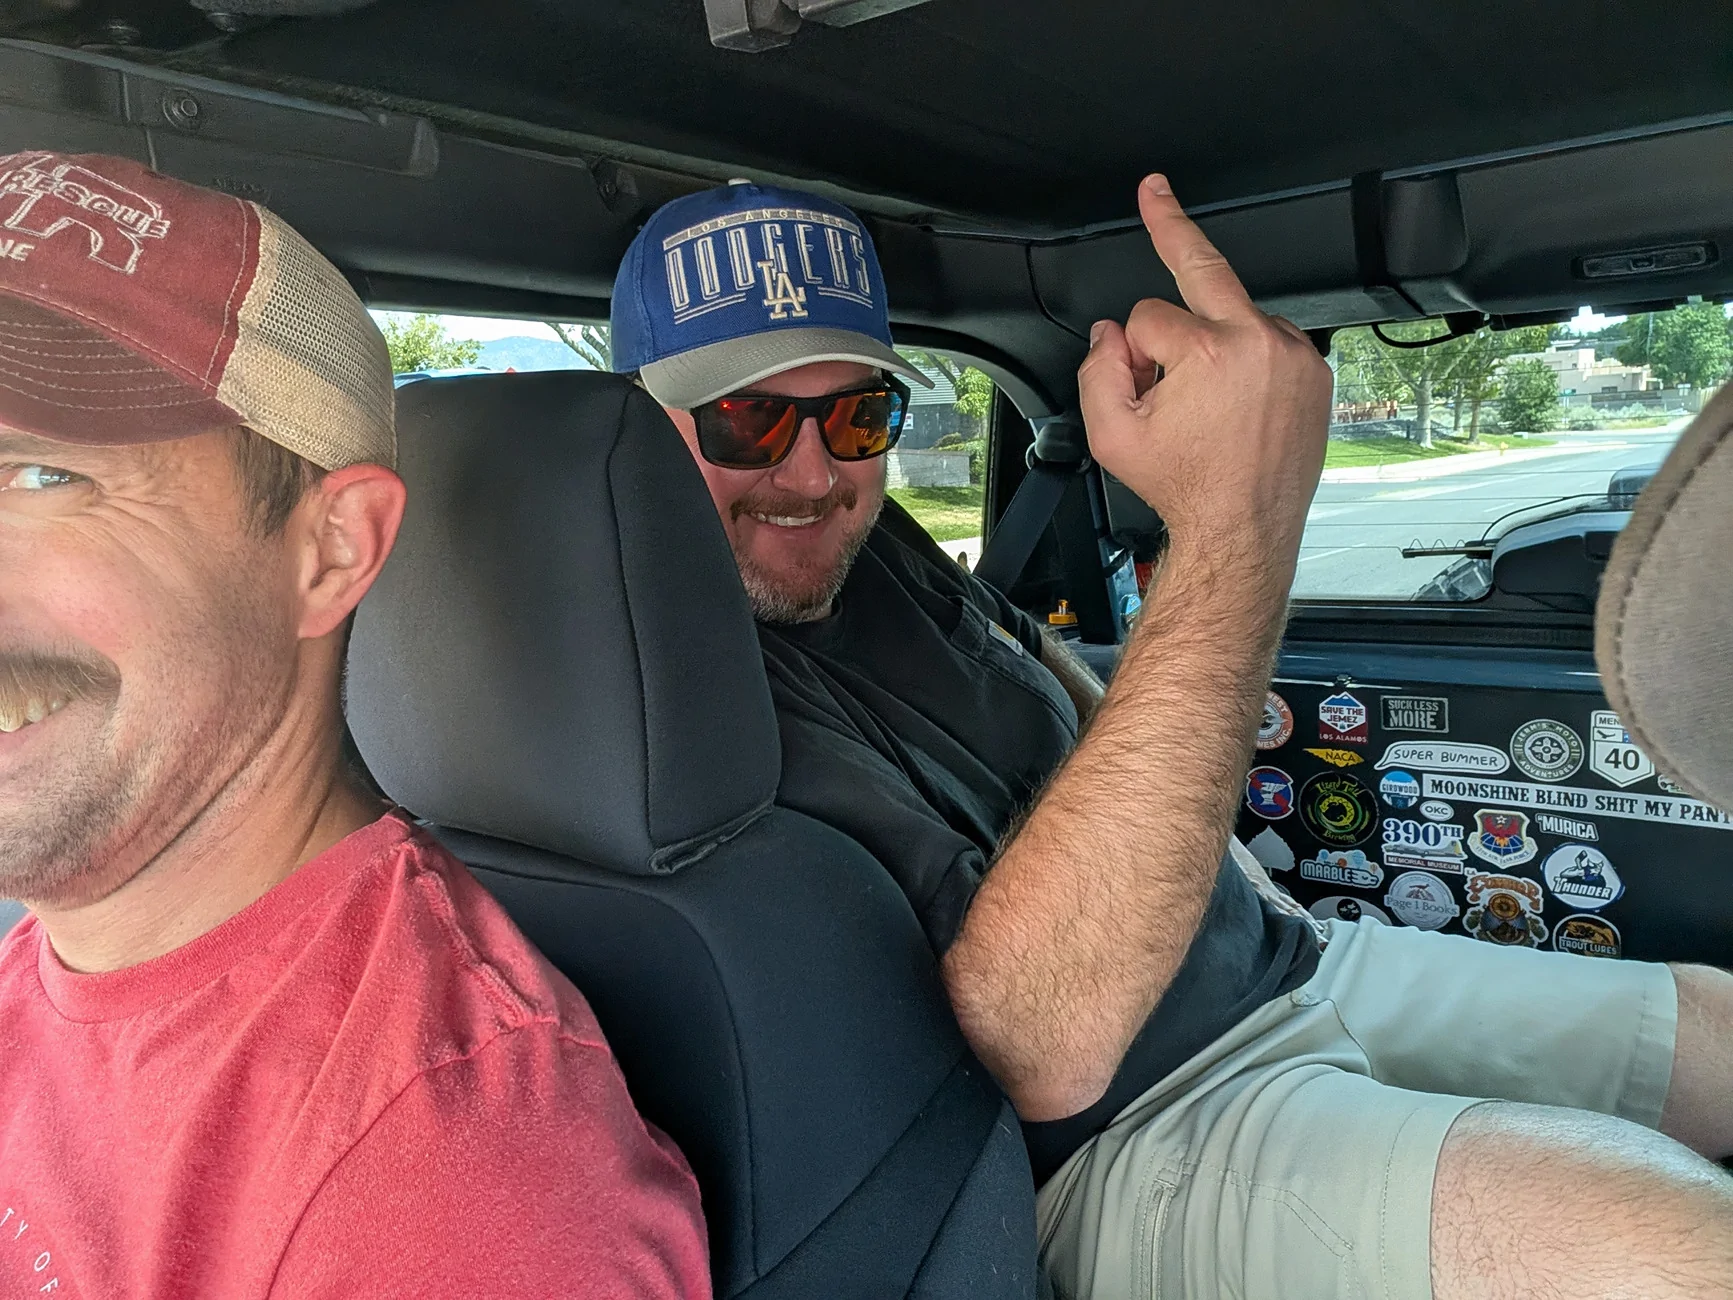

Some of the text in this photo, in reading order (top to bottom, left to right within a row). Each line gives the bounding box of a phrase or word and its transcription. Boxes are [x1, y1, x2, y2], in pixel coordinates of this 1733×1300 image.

[0, 166, 171, 240] RESCUE
[686, 208, 843, 239] LOS ANGELES
[664, 222, 872, 314] DODGERS
[757, 260, 809, 320] LA
[1321, 705, 1364, 716] SAVE THE
[1388, 699, 1439, 712] SUCK LESS
[1327, 714, 1358, 724] JEMEZ
[1389, 709, 1437, 730] MORE
[1320, 733, 1367, 743] LOS ALAMOS
[1555, 725, 1578, 747] MOTO
[1325, 751, 1355, 763] NACA
[1394, 748, 1498, 767] SUPER BUMMER
[1604, 747, 1640, 771] 40
[1520, 761, 1575, 778] ADVENTURES
[1382, 783, 1418, 795] GIRDWOOD
[1431, 779, 1529, 802] MOONSHINE
[1536, 788, 1588, 809] BLIND
[1595, 795, 1638, 815] SHIT
[1645, 800, 1673, 818] MY
[1424, 805, 1449, 817] OKC
[1303, 862, 1351, 883] MARBLE
[1388, 856, 1460, 872] MEMORIAL MUSEUM
[1553, 877, 1613, 899] THUNDER
[1387, 897, 1412, 911] Page
[1422, 902, 1458, 915] Books
[1560, 939, 1618, 955] TROUT LURES
[34, 1251, 59, 1293] OF
